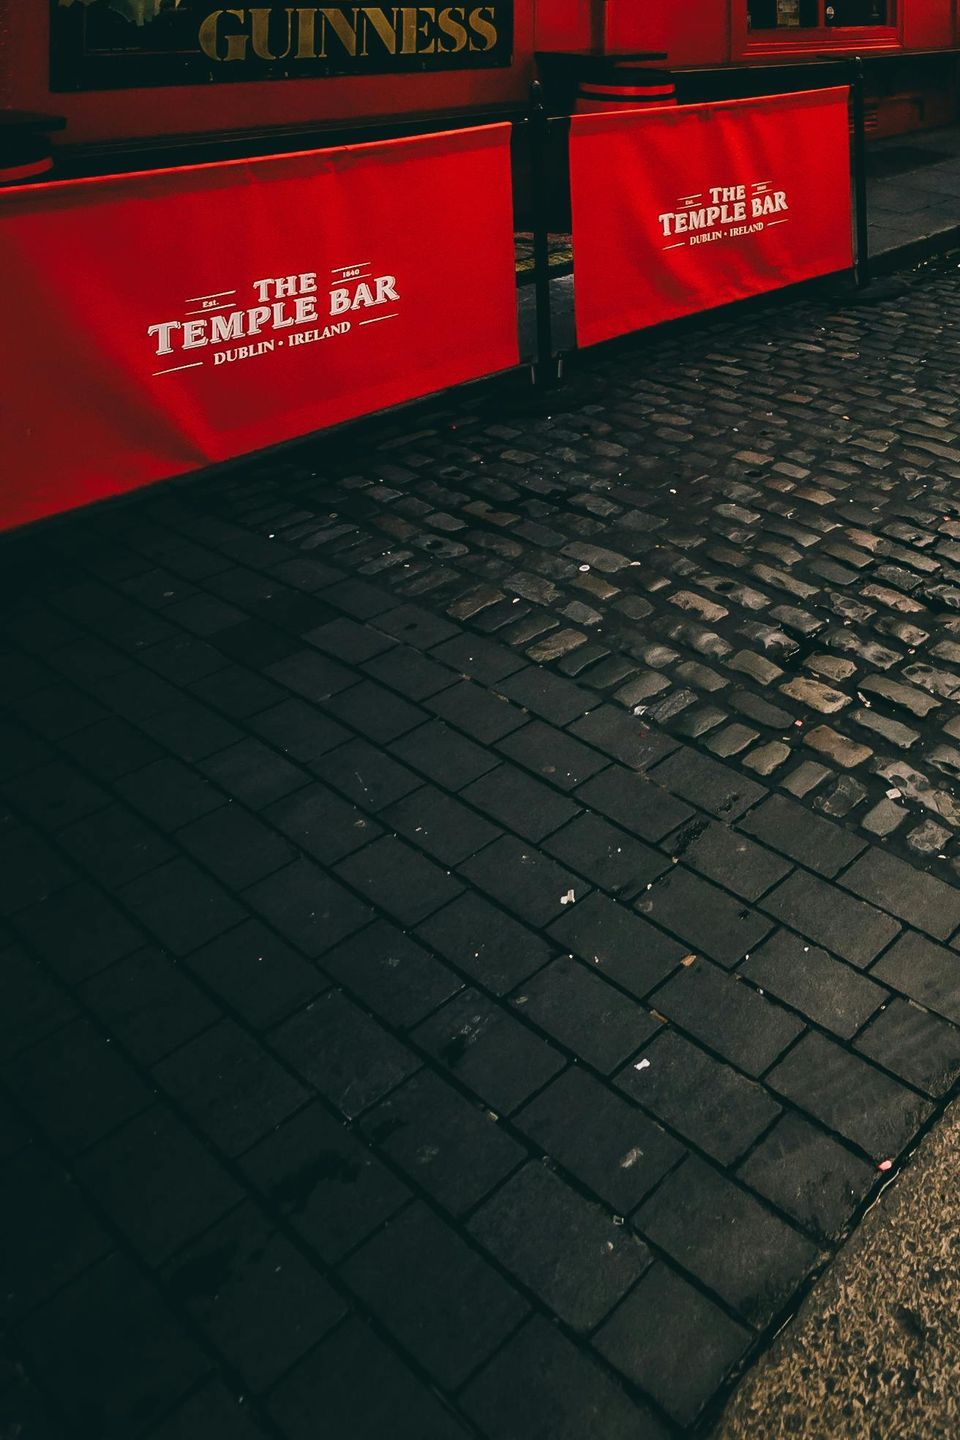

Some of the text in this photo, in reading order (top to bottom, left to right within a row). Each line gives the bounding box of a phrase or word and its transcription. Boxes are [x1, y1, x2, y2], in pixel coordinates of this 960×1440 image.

[198, 6, 499, 62] GUINNESS
[659, 191, 789, 236] TEMPLE BAR
[709, 185, 746, 204] THE
[690, 221, 764, 246] DUBLIN IRELAND
[202, 268, 360, 308] Est. THE 1840
[147, 275, 400, 356] TEMPLE BAR
[214, 321, 352, 366] DUBLIN IRELAND
